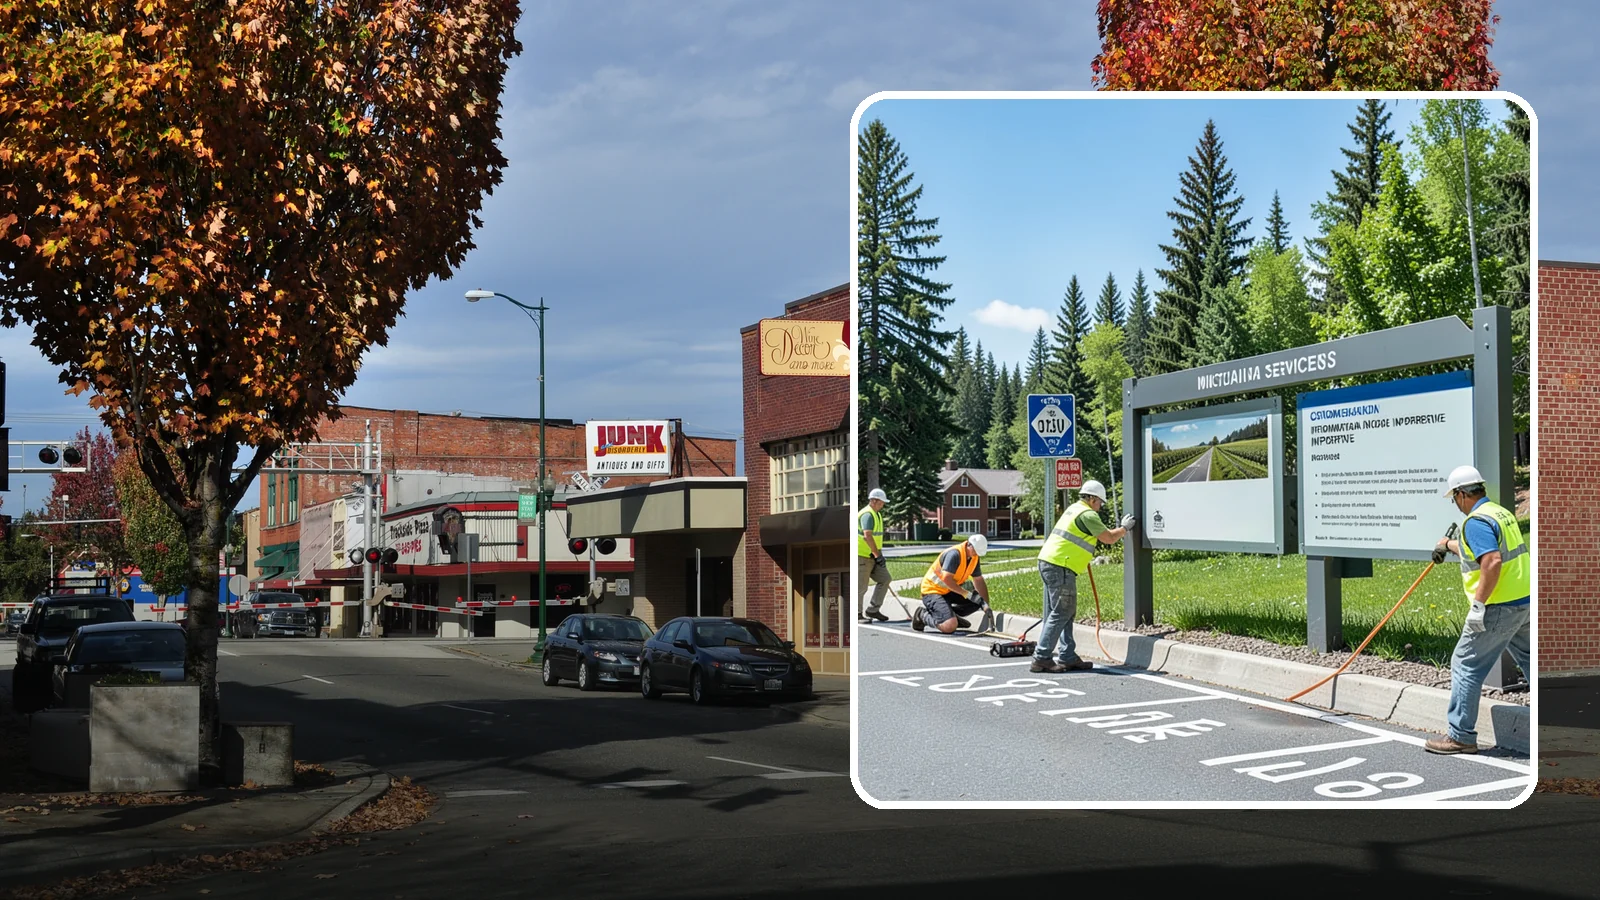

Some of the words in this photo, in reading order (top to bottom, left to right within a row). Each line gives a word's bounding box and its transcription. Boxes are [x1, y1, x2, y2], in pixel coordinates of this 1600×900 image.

[595, 425, 665, 457] JUNK
[607, 446, 646, 454] DISORDERLY
[596, 461, 628, 470] ANTIQUES
[631, 461, 644, 470] AND
[646, 460, 665, 469] GIFTS
[390, 521, 413, 540] Trackside
[415, 519, 429, 534] Pizza
